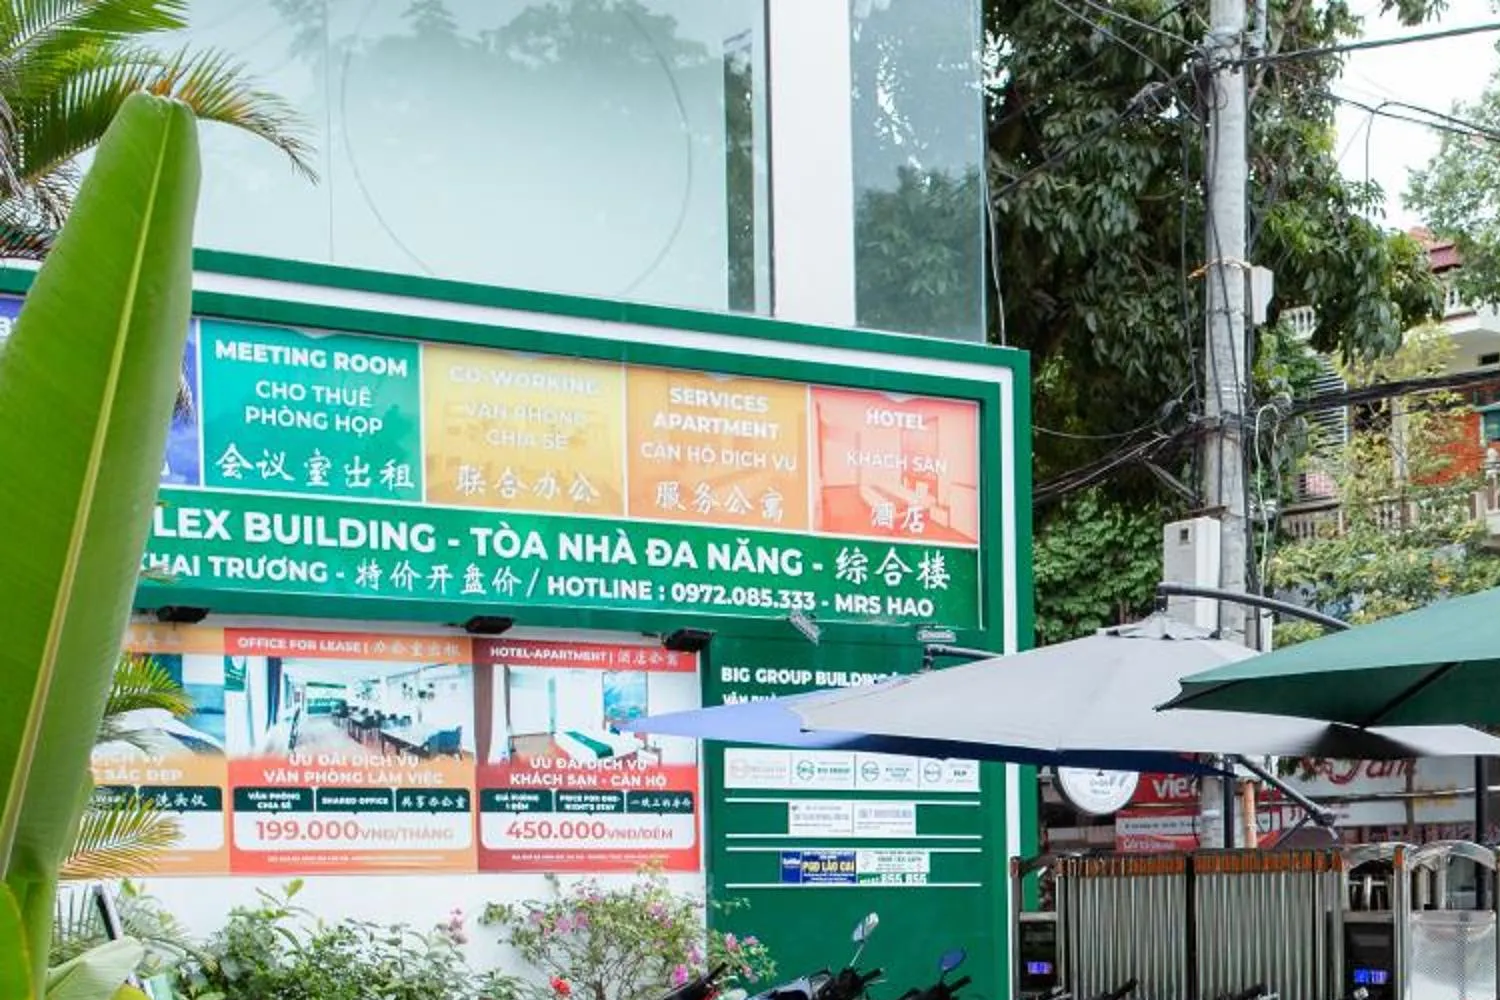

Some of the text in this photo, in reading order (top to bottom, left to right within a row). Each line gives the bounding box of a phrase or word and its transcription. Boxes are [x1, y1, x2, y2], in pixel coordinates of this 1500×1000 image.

[214, 339, 408, 377] MEETING ROOM
[255, 380, 373, 408] CHO THUÊ
[669, 386, 770, 414] SERVICES
[244, 404, 384, 439] PHÒNG HỌP
[653, 411, 780, 441] APARTMENT
[866, 407, 928, 431] HOTEL
[215, 442, 416, 491] 会议室出租
[243, 510, 437, 553] BUILDING
[469, 520, 549, 561] TÒA
[558, 528, 637, 565] NHÀ
[645, 537, 699, 570] ĐA
[706, 537, 802, 577] NĂNG
[835, 546, 950, 591] 综合楼
[207, 554, 329, 583] TRƯƠNG
[547, 574, 653, 602] HOTLINE
[671, 582, 816, 611] 0972.085.333
[835, 594, 881, 616] MRS
[887, 597, 935, 618] HAO
[237, 635, 287, 650] OFFICE
[289, 638, 317, 651] FOR
[319, 640, 361, 653] LEASE
[721, 666, 750, 683] BIG
[755, 668, 812, 686] GROUP
[509, 770, 564, 786] KHÁCH
